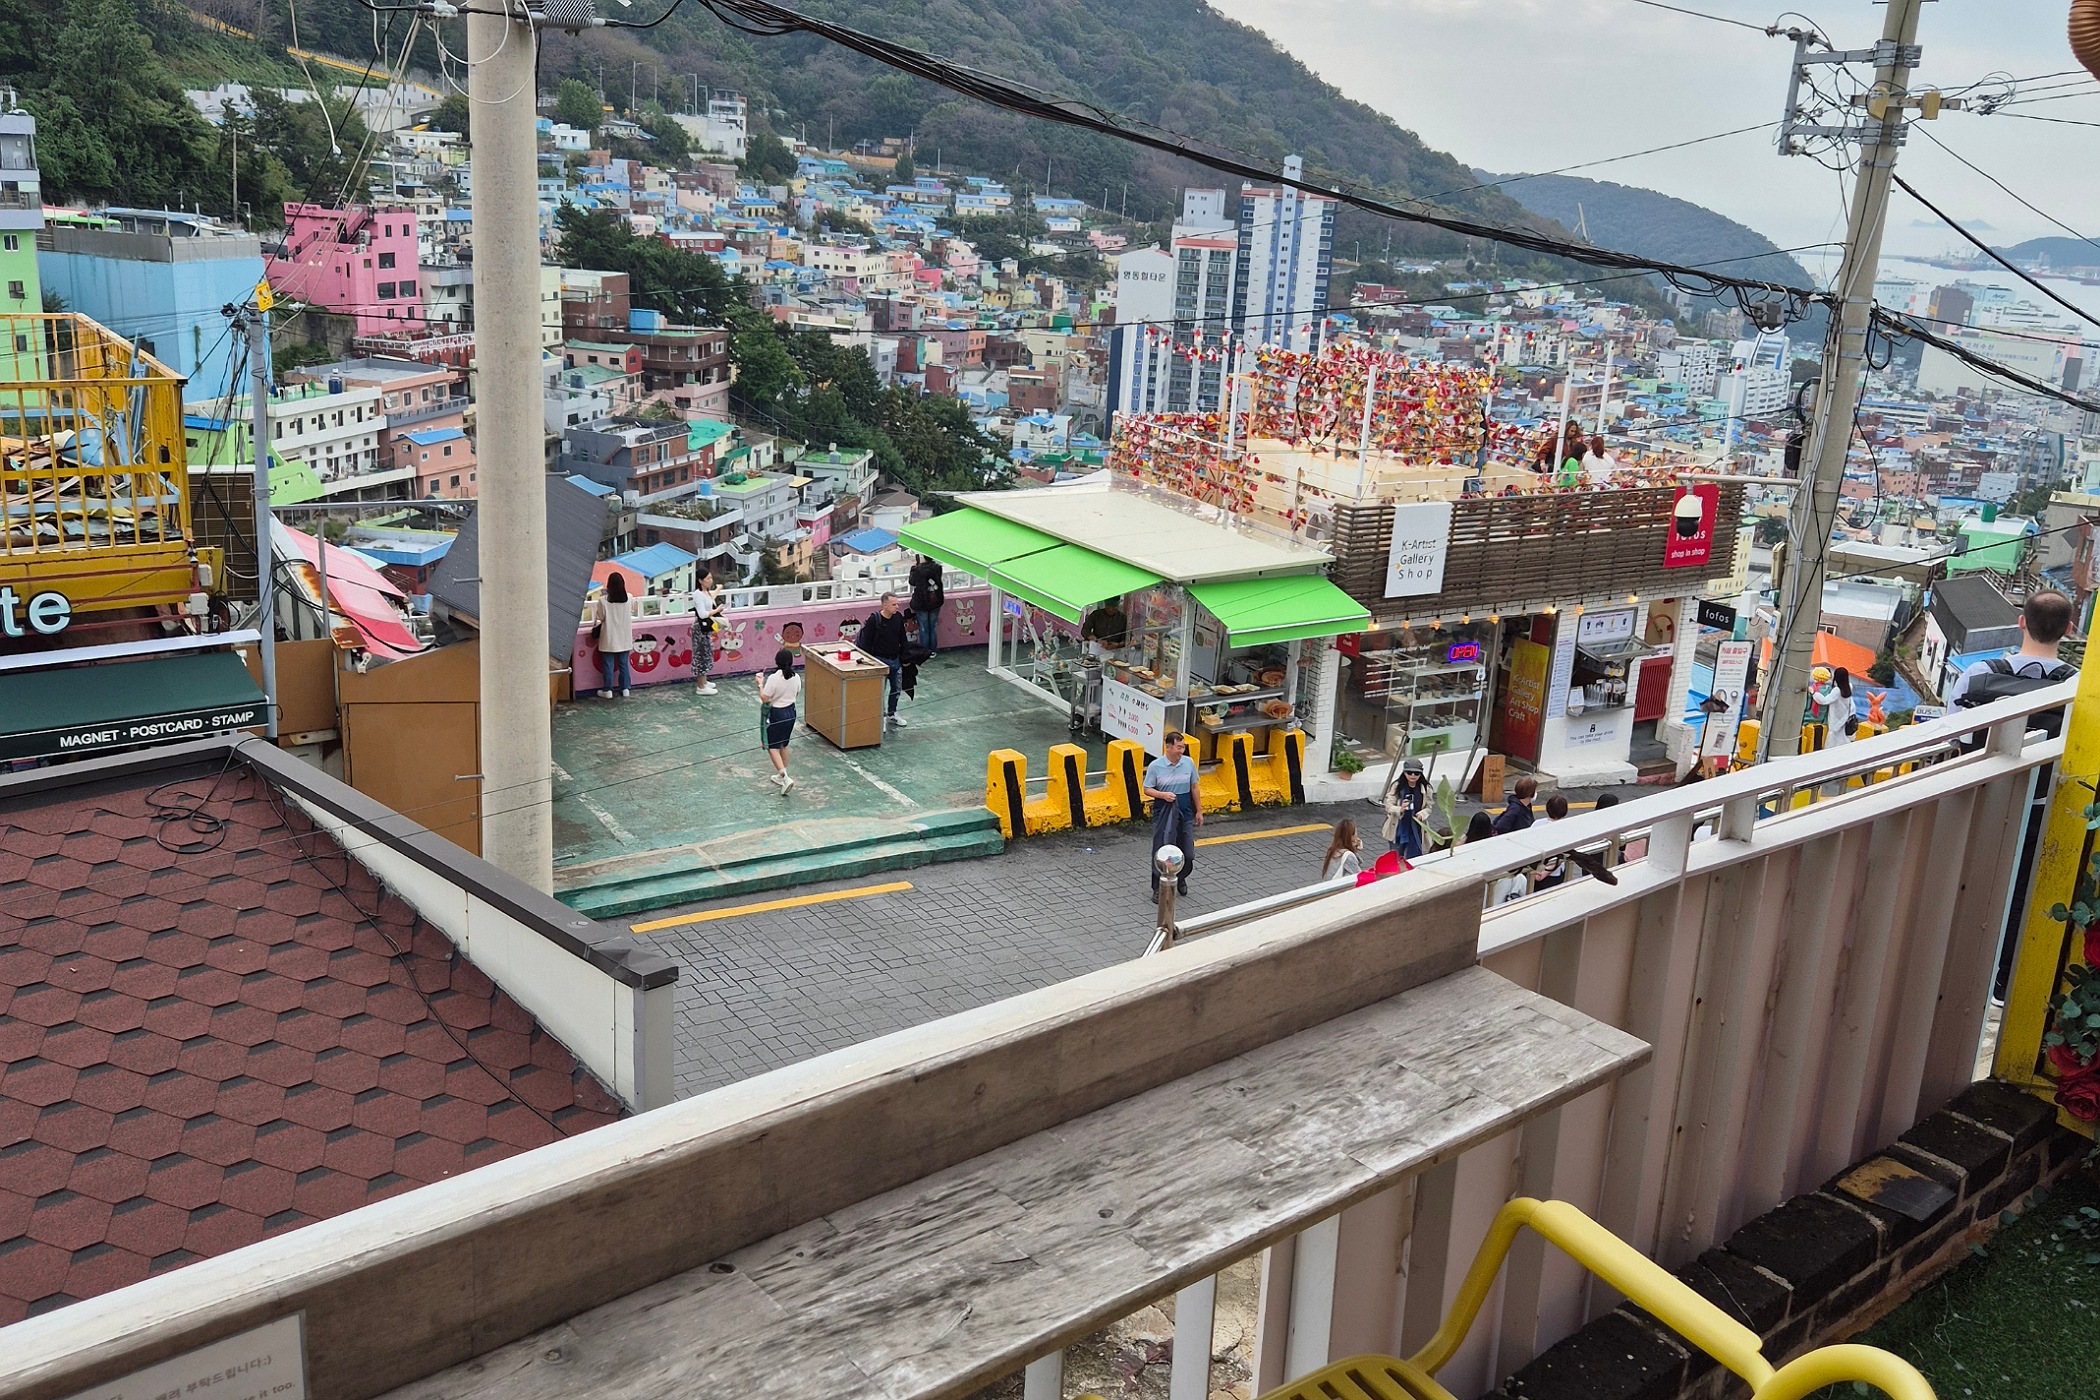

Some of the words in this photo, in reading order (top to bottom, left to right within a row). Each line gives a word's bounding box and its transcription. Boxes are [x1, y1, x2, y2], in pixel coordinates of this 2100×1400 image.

[1401, 540, 1437, 551] K-Artist
[1691, 547, 1705, 556] shop
[1400, 553, 1434, 566] Gallery
[1398, 568, 1433, 580] Shop
[1705, 609, 1729, 623] fofos
[1450, 645, 1478, 658] OPEN
[1513, 674, 1540, 690] K-Artist
[1511, 685, 1535, 702] Gallery
[1510, 697, 1520, 707] Art
[1522, 701, 1539, 715] Shop
[1508, 708, 1525, 721] Craft
[60, 729, 119, 748] MAGNET
[130, 718, 203, 738] POSTCARD
[212, 711, 255, 726] STAMP
[259, 1390, 268, 1399] it
[272, 1382, 296, 1394] too.
